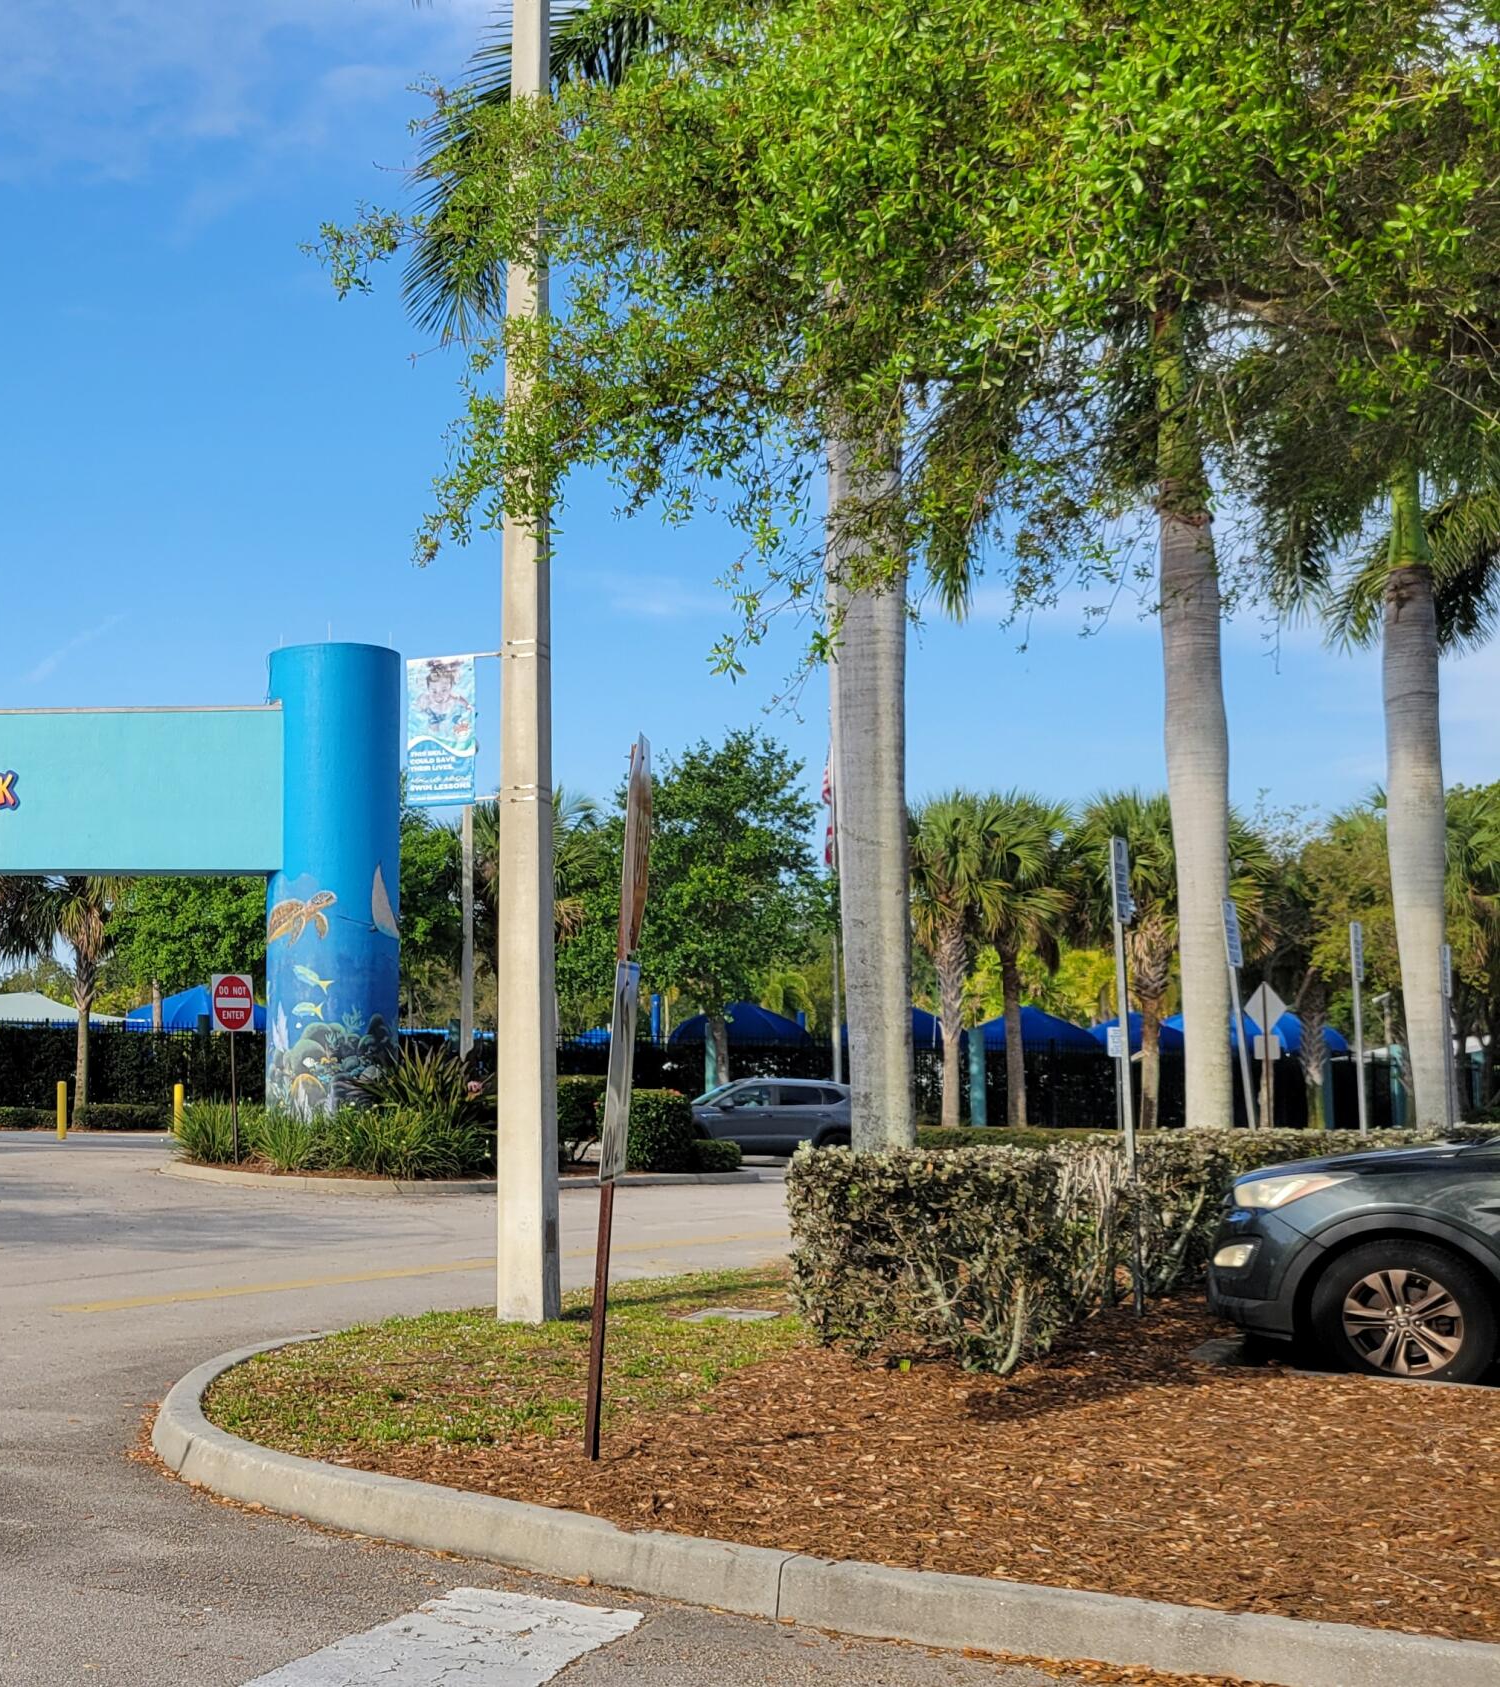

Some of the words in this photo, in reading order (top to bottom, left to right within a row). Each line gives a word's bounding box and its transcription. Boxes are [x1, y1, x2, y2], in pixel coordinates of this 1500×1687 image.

[409, 784, 433, 792] SWIM
[434, 782, 471, 791] LESSONS
[218, 985, 229, 995] DO
[232, 986, 246, 996] NOT
[222, 1010, 245, 1020] ENTER
